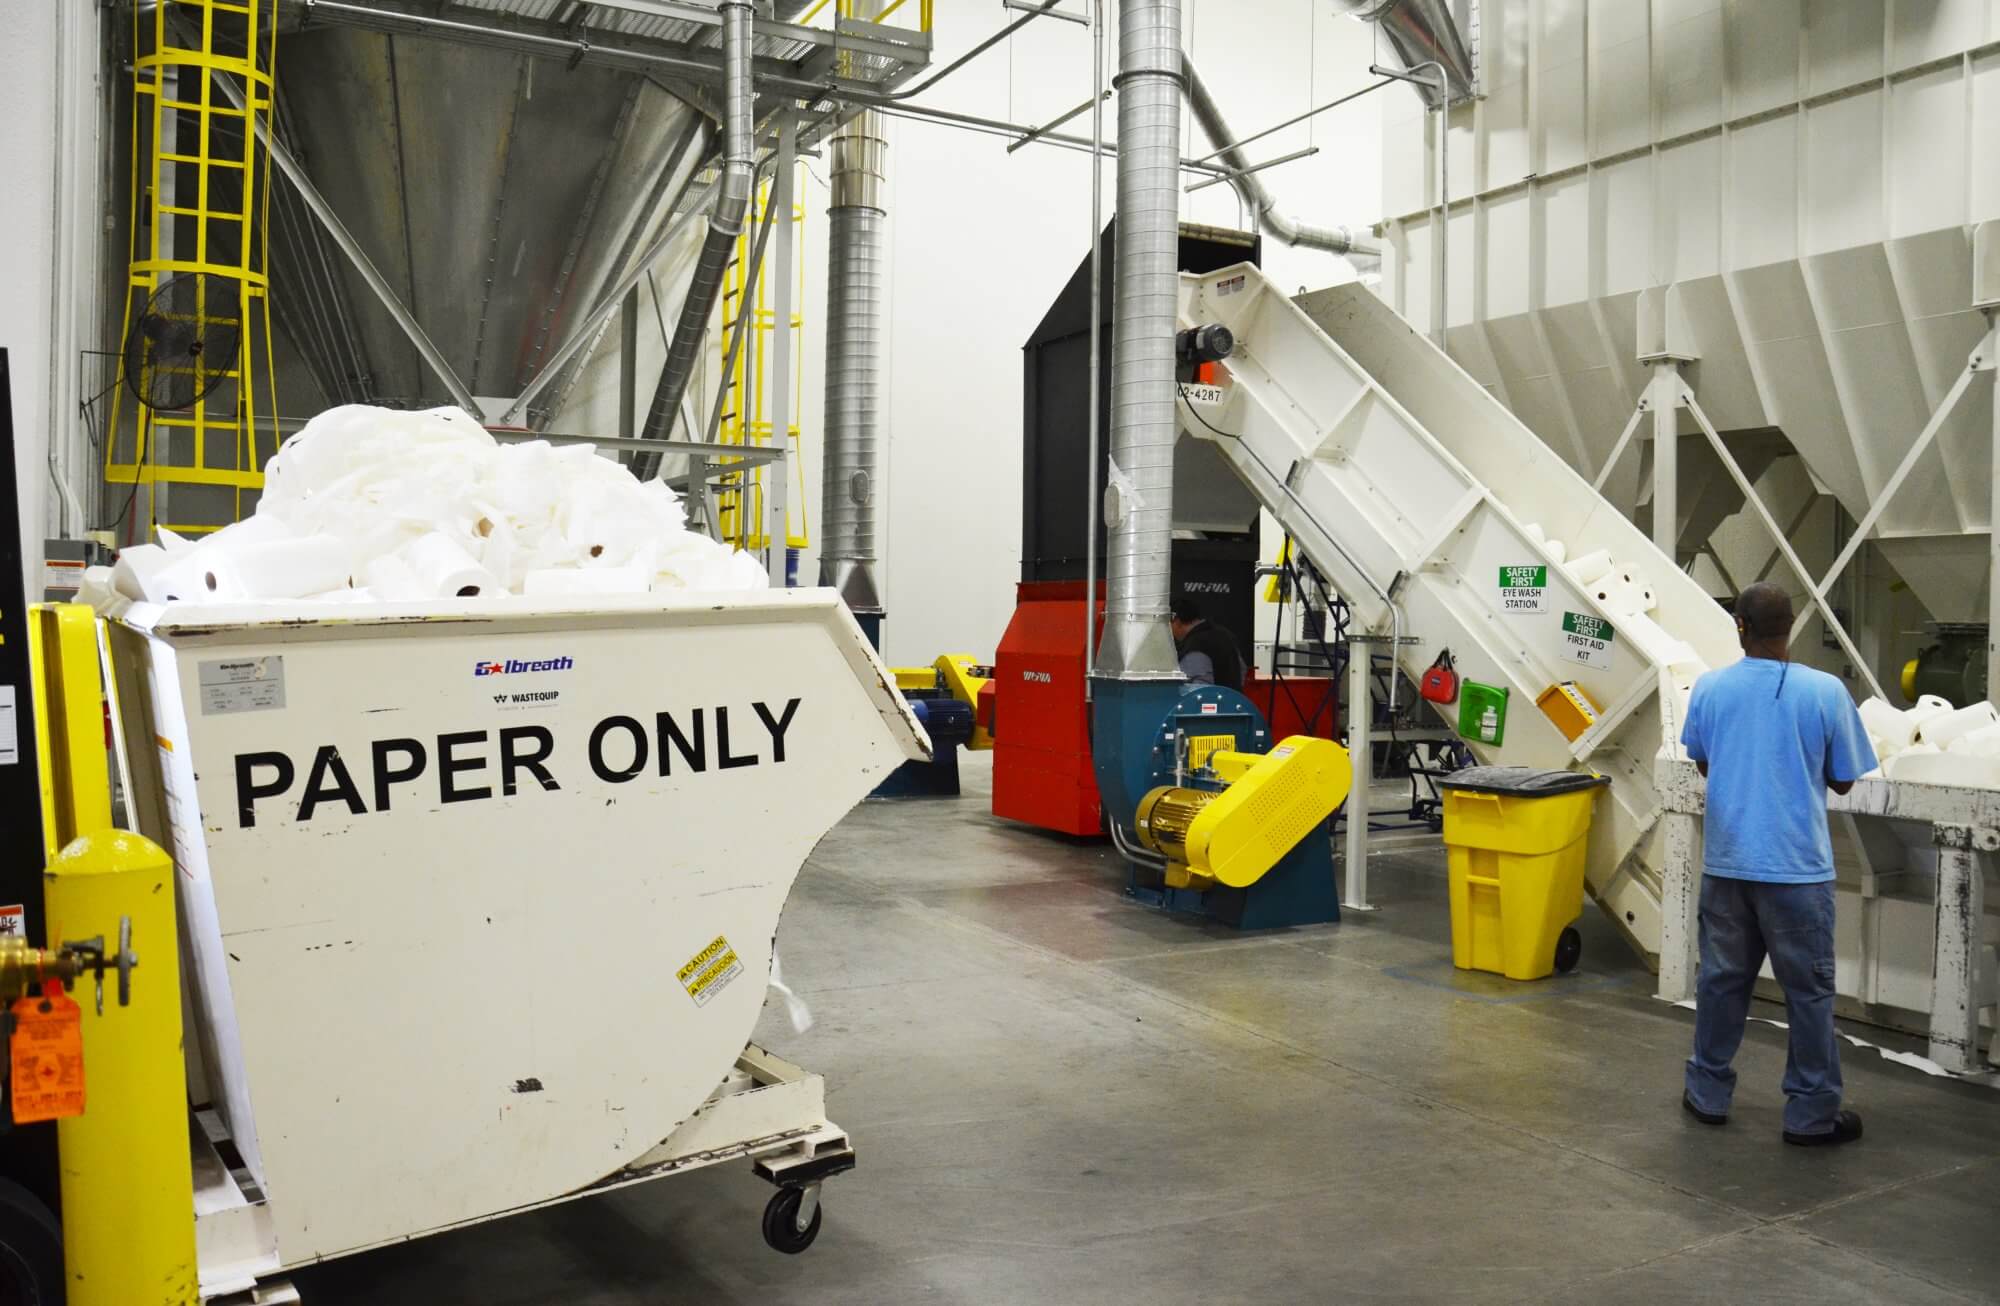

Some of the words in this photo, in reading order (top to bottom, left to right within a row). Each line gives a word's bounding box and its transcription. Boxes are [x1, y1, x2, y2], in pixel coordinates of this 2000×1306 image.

[1506, 567, 1539, 577] SAFETY
[1510, 576, 1535, 587] FIRST
[1502, 588, 1517, 598] EYE
[1517, 588, 1542, 598] WASH
[1505, 599, 1538, 609] STATION
[1572, 614, 1604, 629] SAFETY
[1575, 625, 1600, 638] FIRST
[1567, 635, 1588, 648] FIRST
[1590, 640, 1605, 651] AID
[1576, 650, 1591, 661] KIT
[475, 656, 573, 676] Glbreath
[511, 690, 559, 703] WASTEQUIP
[233, 724, 562, 829] PAPER
[588, 697, 802, 784] ONLY
[686, 938, 724, 973] CAUTION
